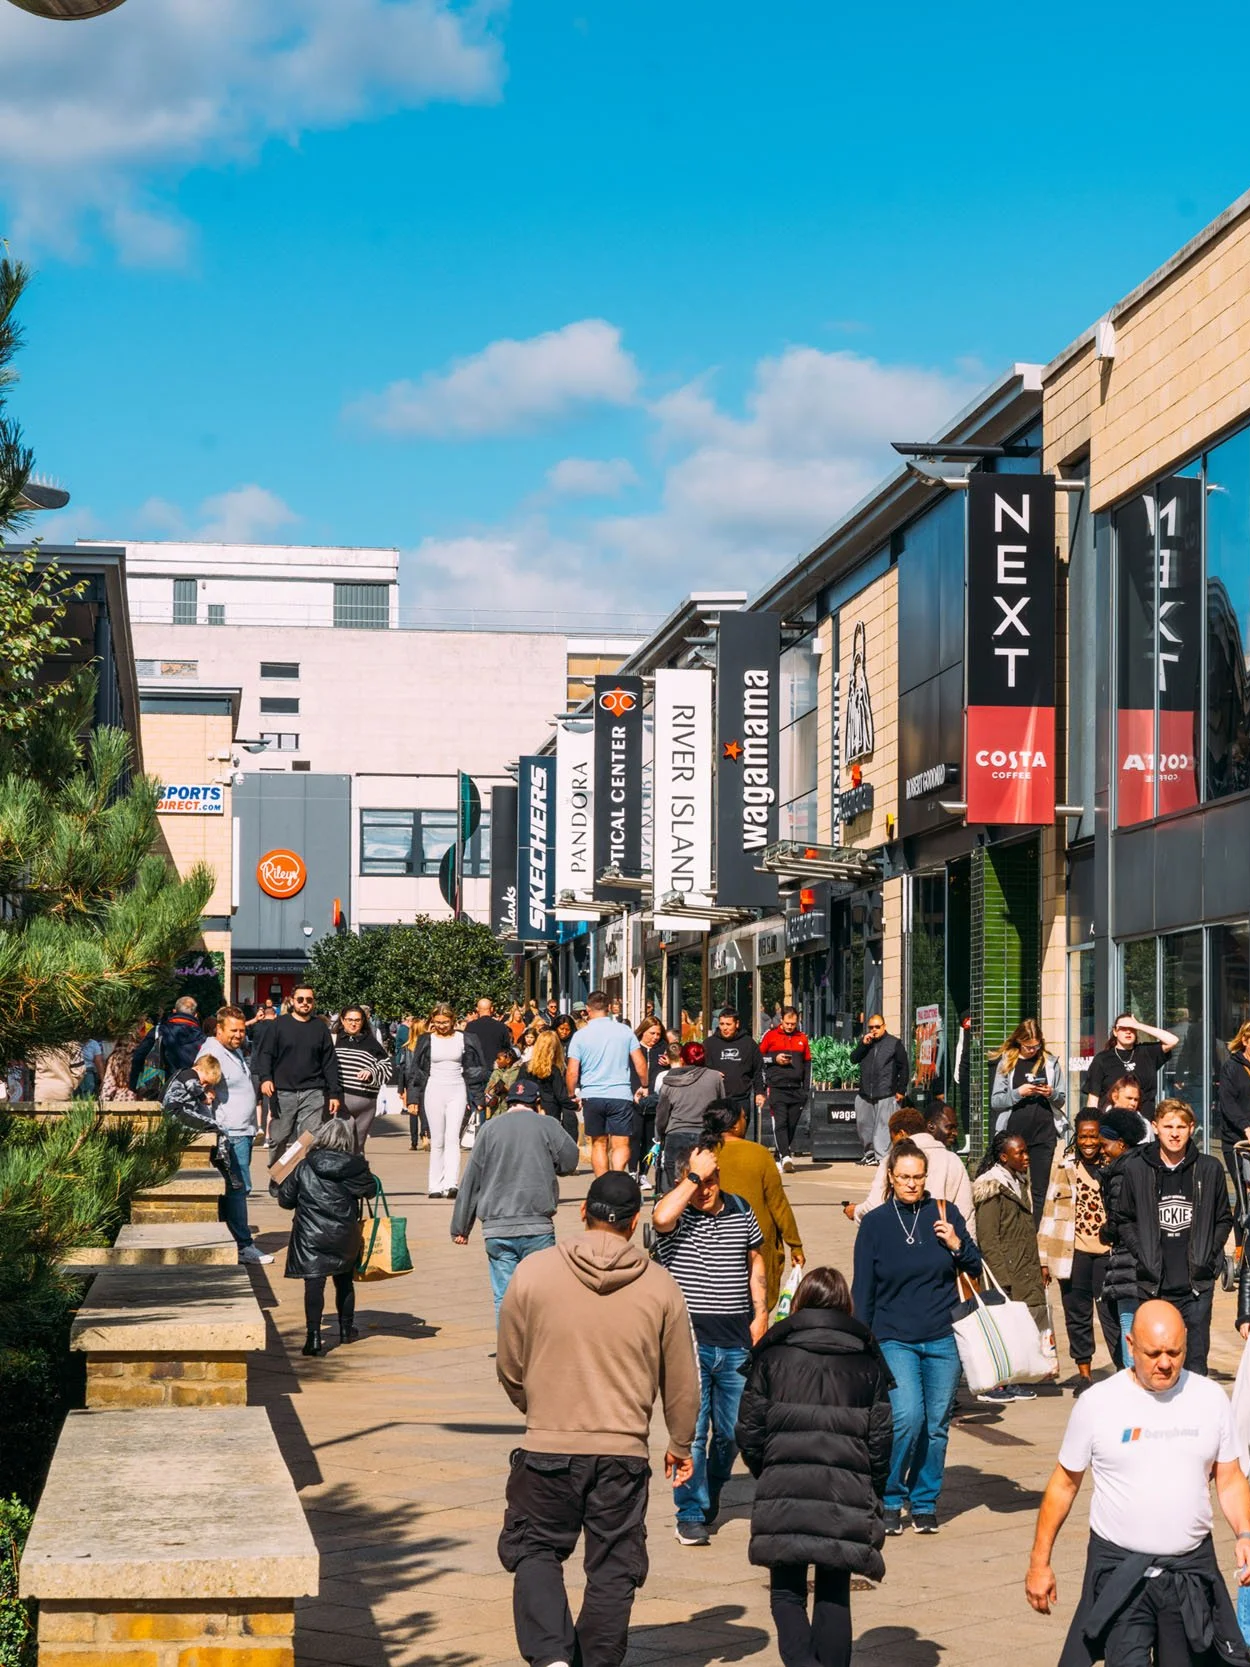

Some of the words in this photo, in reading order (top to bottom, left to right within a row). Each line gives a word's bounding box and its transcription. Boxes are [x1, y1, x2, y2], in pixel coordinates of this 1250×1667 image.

[993, 492, 1031, 688] NEXT
[611, 725, 626, 803] CENTER
[671, 704, 696, 782] RIVER
[743, 669, 775, 851] wagamama
[976, 750, 1047, 769] COSTA
[158, 786, 221, 800] SPORTS
[992, 771, 1032, 780] COFFEE
[570, 761, 588, 873] PANDORA
[670, 795, 695, 893] ISLAND
[260, 861, 299, 887] Rileys
[529, 764, 547, 932] SKECHERS
[500, 885, 516, 930] larks
[831, 1110, 856, 1121] waga
[1159, 1207, 1192, 1224] ICKIE
